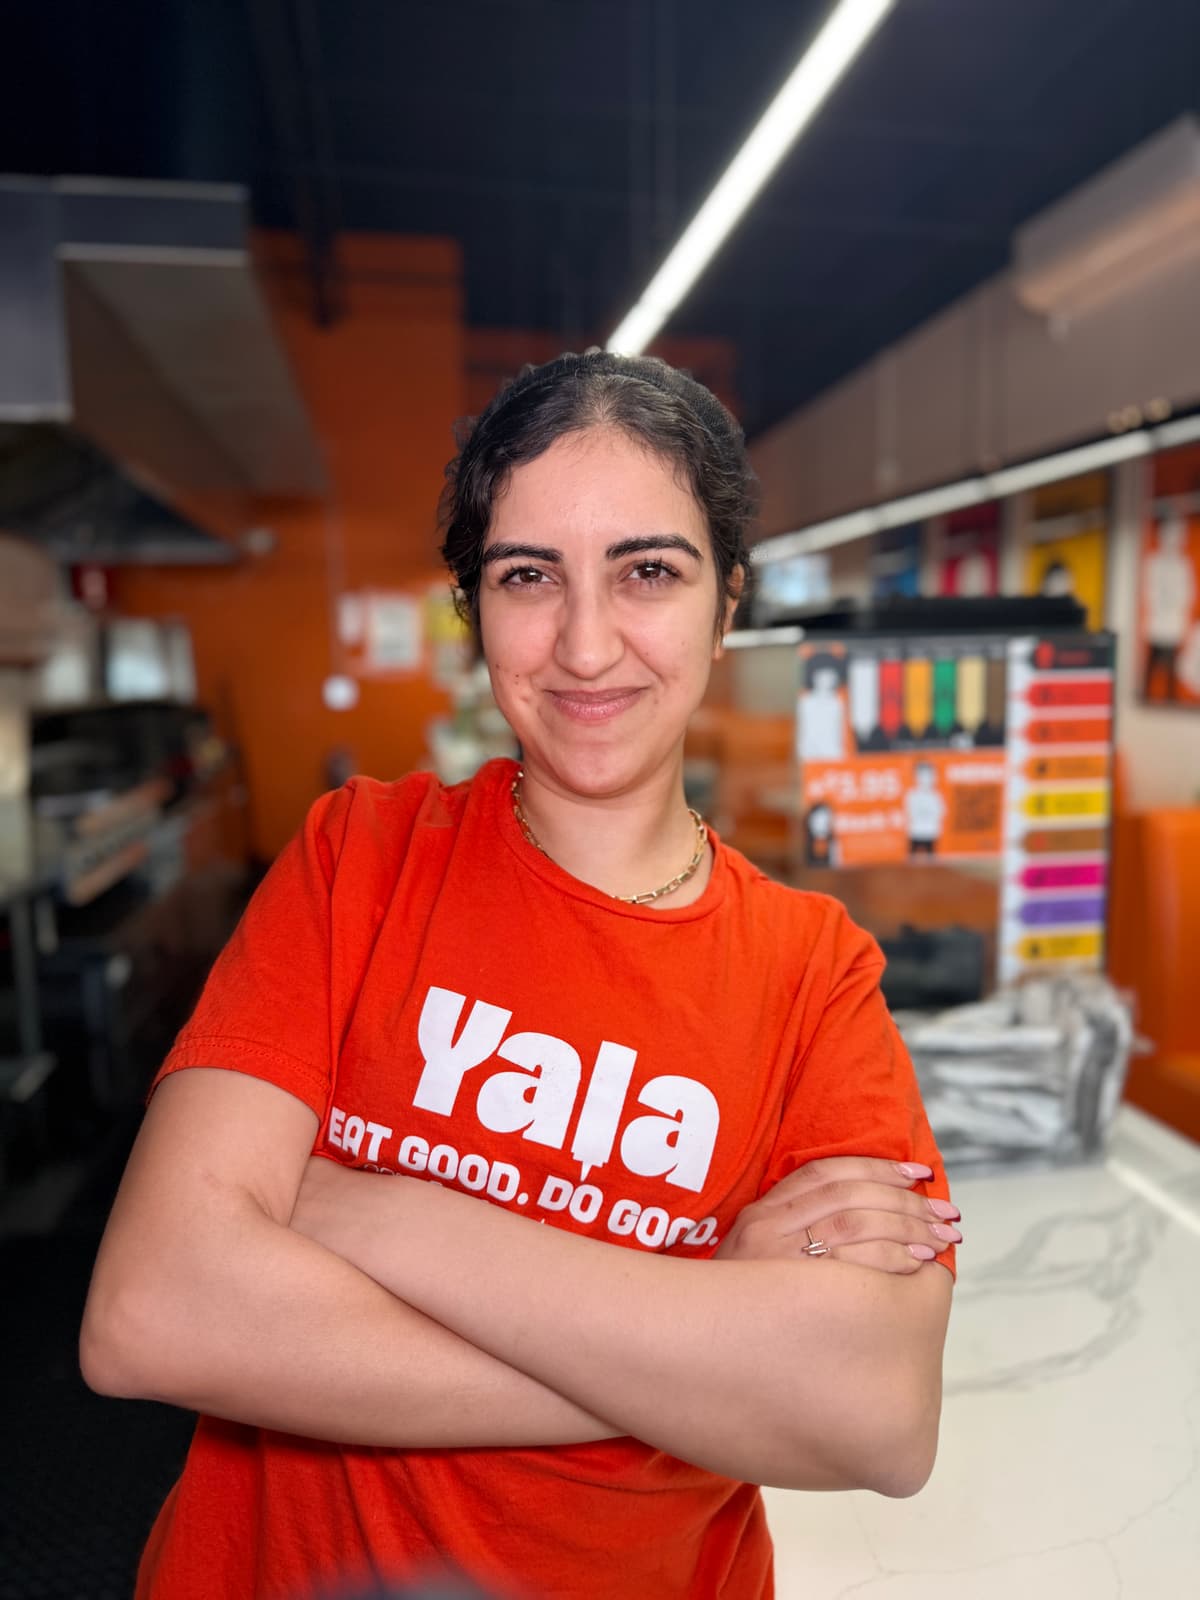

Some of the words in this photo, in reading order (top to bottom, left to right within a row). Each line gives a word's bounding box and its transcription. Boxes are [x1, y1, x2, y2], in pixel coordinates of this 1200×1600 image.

[328, 1106, 393, 1162] EAT
[397, 1135, 529, 1206] GOOD.
[537, 1175, 604, 1224] DO
[412, 986, 720, 1193] Yala
